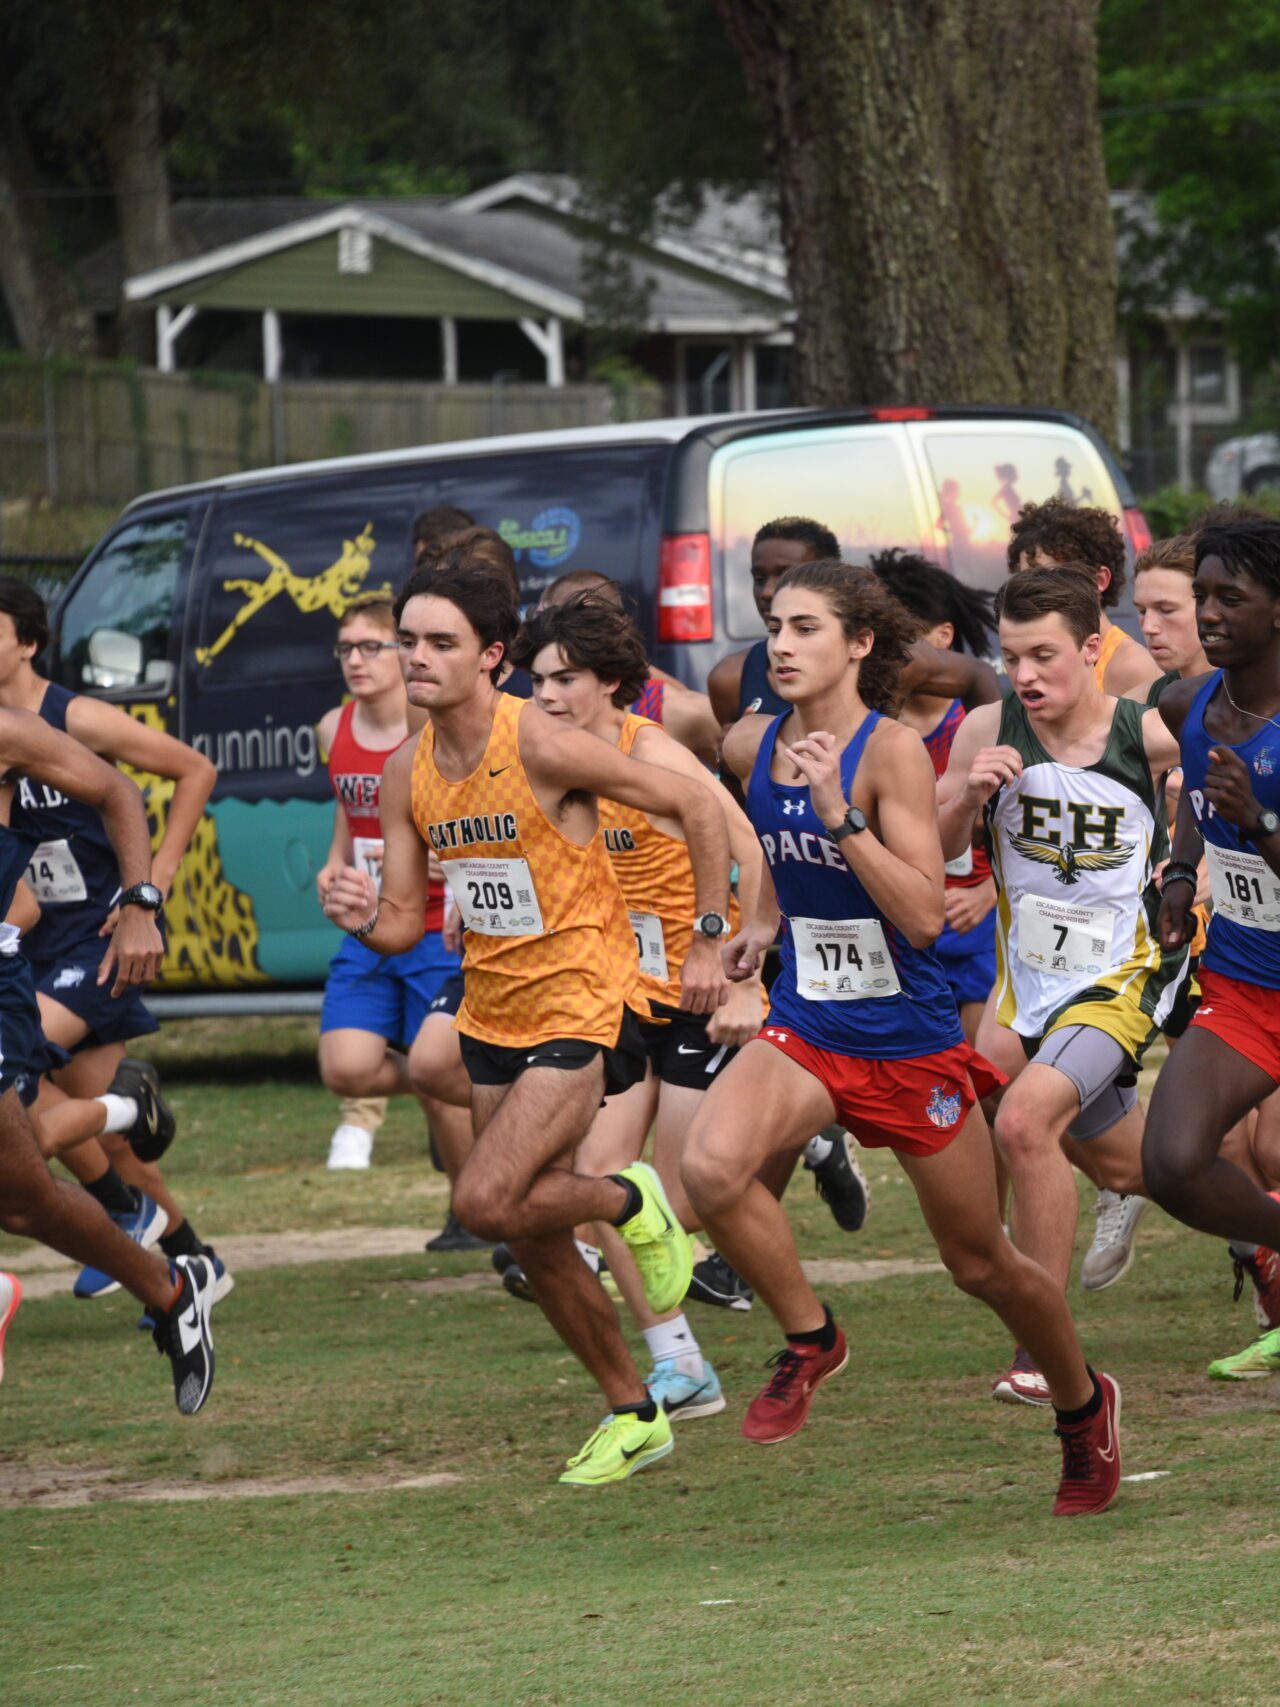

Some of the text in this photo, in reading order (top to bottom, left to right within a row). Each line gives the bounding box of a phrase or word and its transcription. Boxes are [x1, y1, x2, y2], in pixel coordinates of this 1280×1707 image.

[192, 714, 316, 777] running
[333, 774, 382, 804] WE
[427, 813, 518, 851] CATHOLIC
[1017, 794, 1125, 849] EH
[761, 830, 849, 872] PACE
[467, 881, 514, 910] 209
[1225, 871, 1264, 905] 181
[1053, 924, 1068, 951] 7
[815, 943, 863, 972] 174
